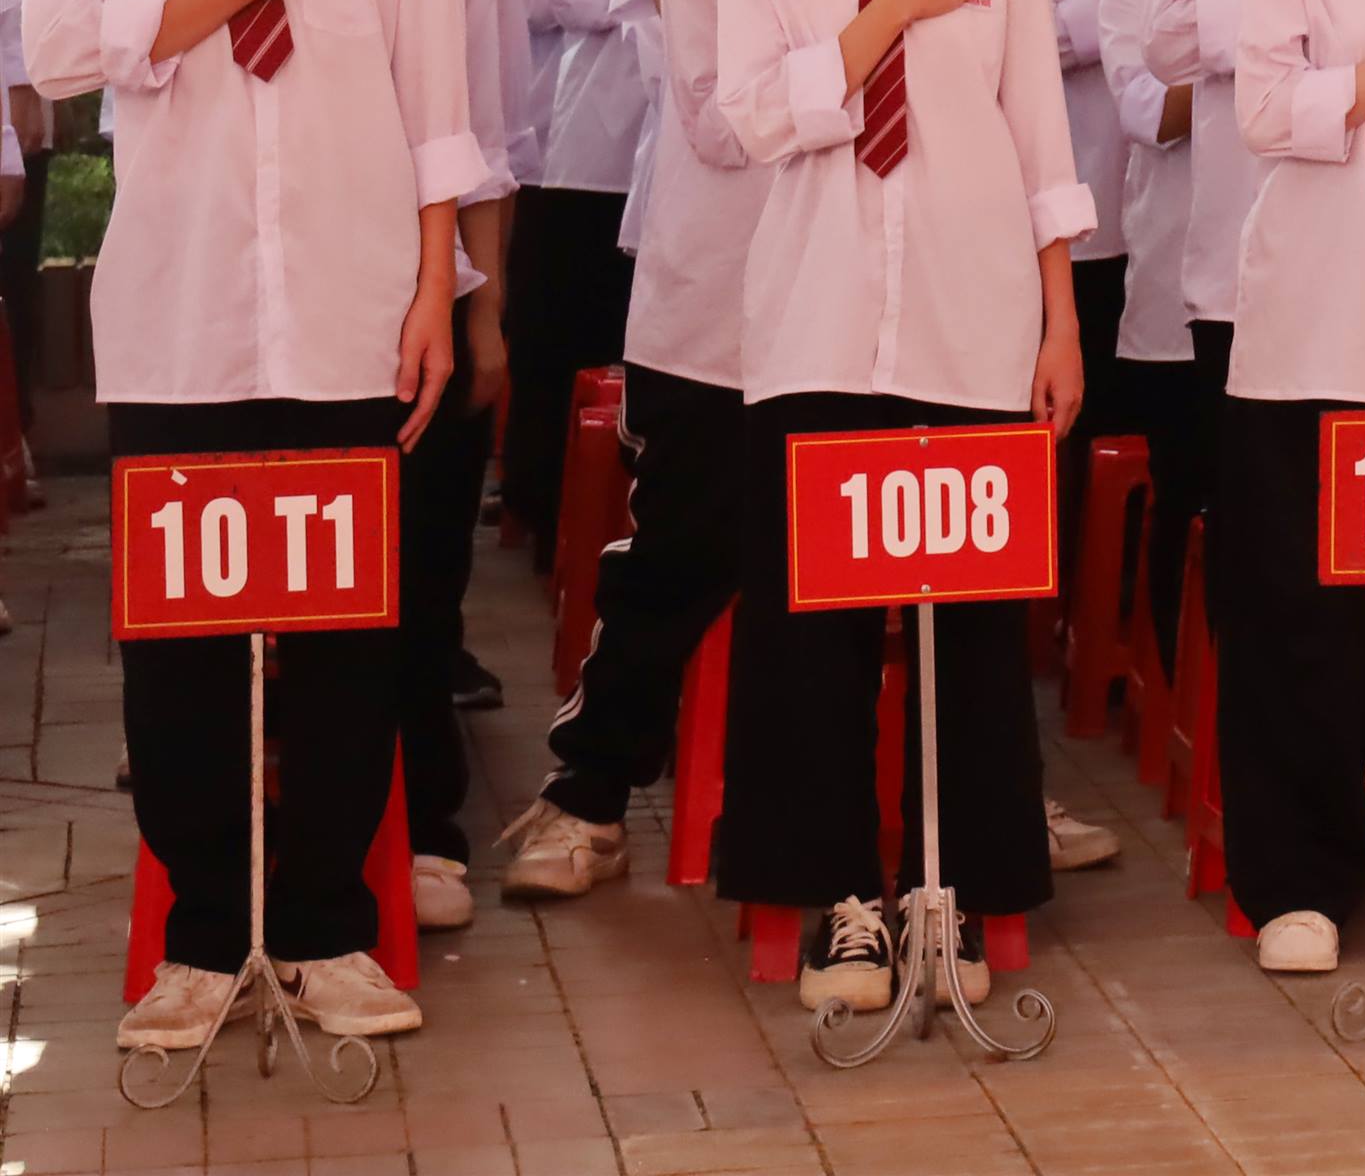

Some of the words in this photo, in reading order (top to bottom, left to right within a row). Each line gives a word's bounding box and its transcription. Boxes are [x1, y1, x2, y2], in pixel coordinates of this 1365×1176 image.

[150, 494, 249, 600] 10
[273, 494, 356, 593] T1
[839, 464, 1011, 560] 10D8
